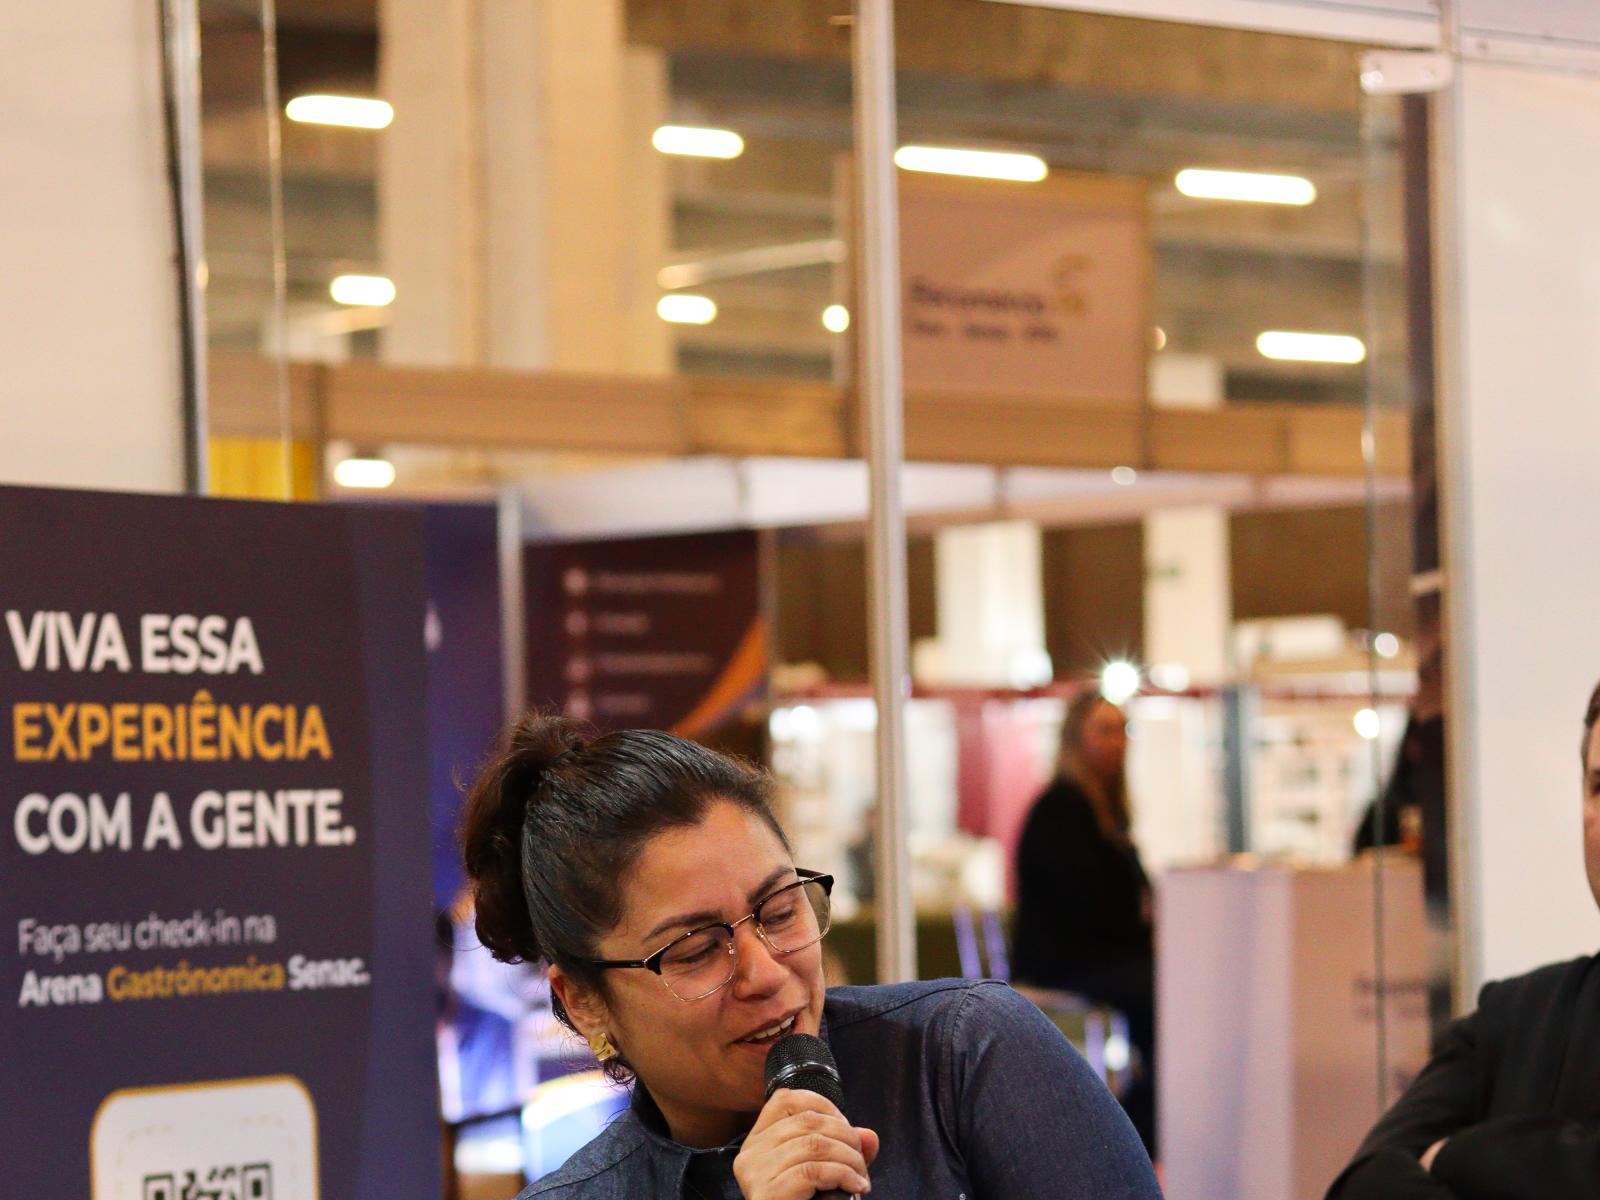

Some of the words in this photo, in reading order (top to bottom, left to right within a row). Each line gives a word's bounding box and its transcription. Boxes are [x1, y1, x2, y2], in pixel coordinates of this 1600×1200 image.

[6, 610, 132, 672] VIVA
[141, 614, 264, 674] ESSA
[13, 688, 333, 761] EXPERIÊNCIA
[14, 792, 132, 854] COM
[143, 792, 182, 851] A
[190, 789, 356, 849] GENTE.
[18, 917, 82, 963] Faça
[84, 922, 132, 953] seu
[134, 909, 241, 950] check-in
[243, 914, 277, 944] na
[18, 970, 103, 1007] Arena
[288, 954, 371, 990] Senac.
